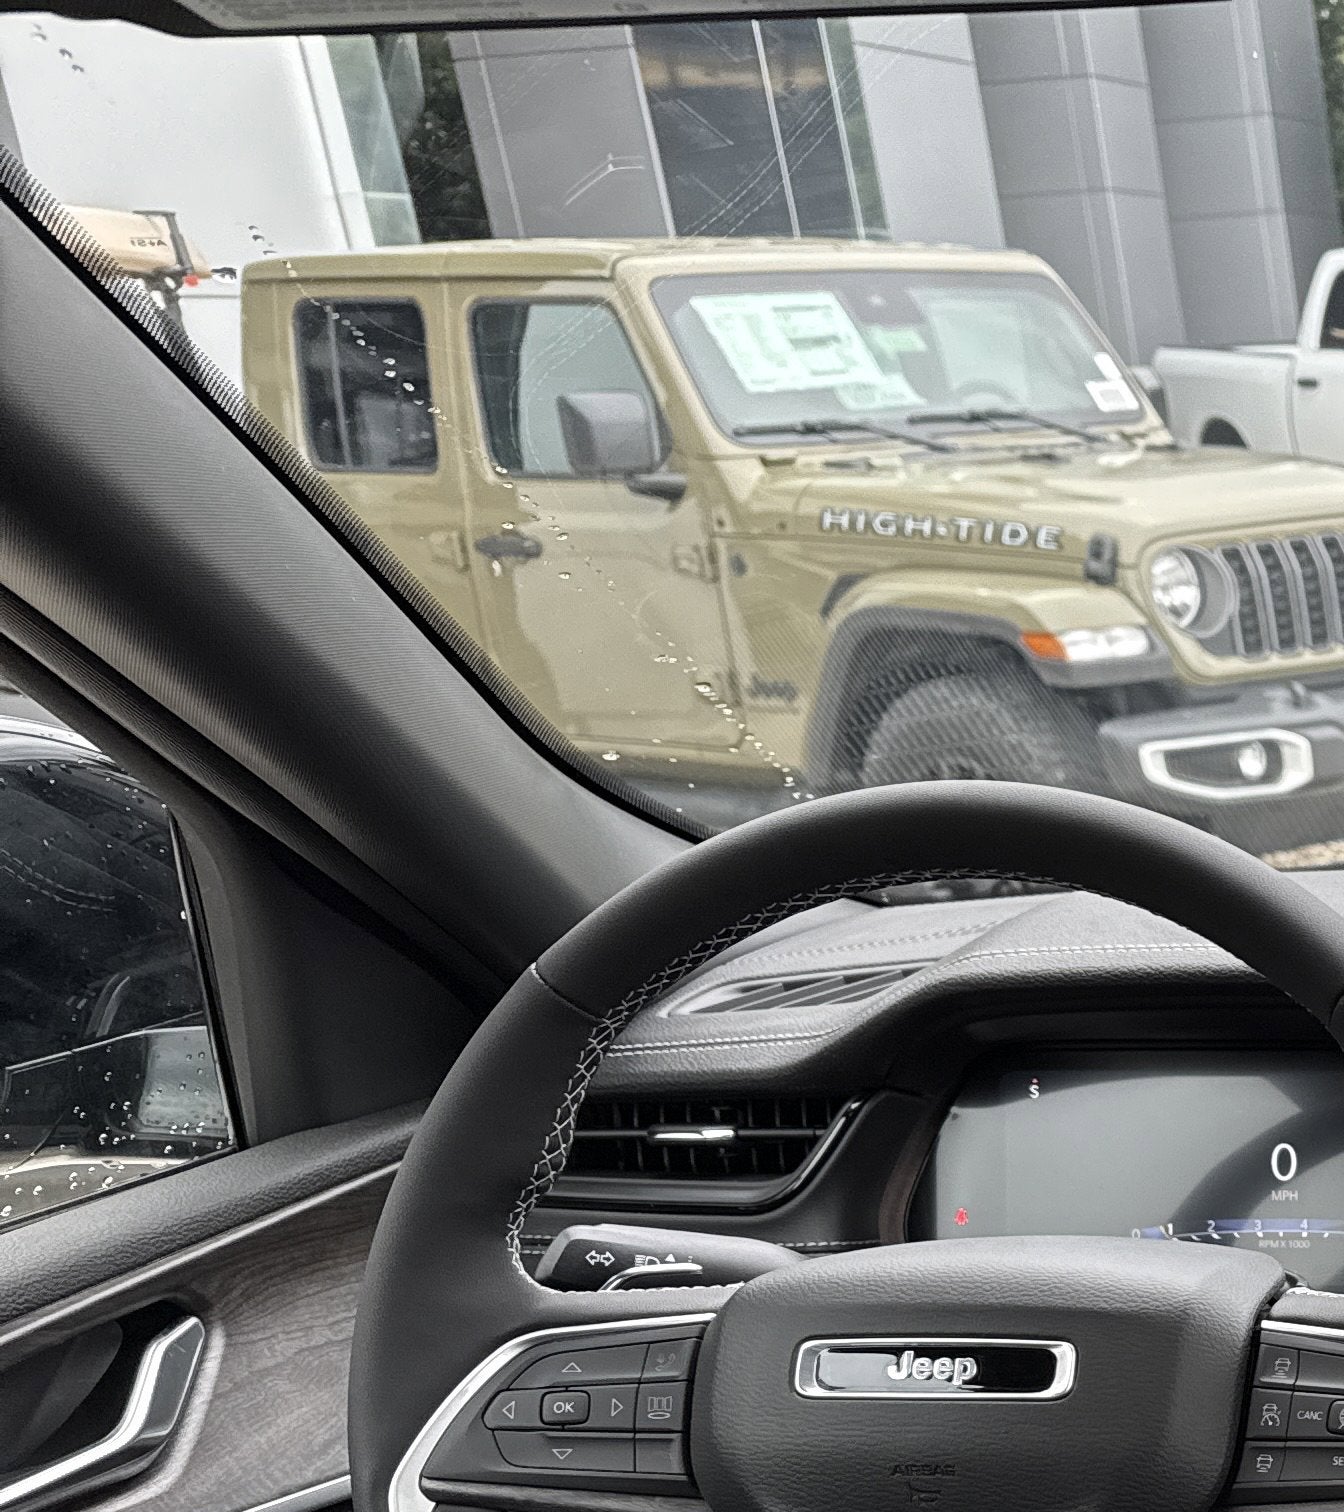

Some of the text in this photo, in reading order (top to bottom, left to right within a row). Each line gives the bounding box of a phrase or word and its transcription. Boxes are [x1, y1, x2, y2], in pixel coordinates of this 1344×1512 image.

[1271, 1142, 1298, 1181] 0
[1271, 1190, 1298, 1201] MPH
[1207, 1220, 1216, 1232] 2
[1254, 1220, 1262, 1231] 3
[1300, 1219, 1308, 1230] 4
[1258, 1240, 1279, 1248] RPM
[1289, 1240, 1310, 1248] 1000
[887, 1350, 978, 1386] Jeep
[553, 1402, 575, 1414] OK
[1297, 1411, 1324, 1421] CANC
